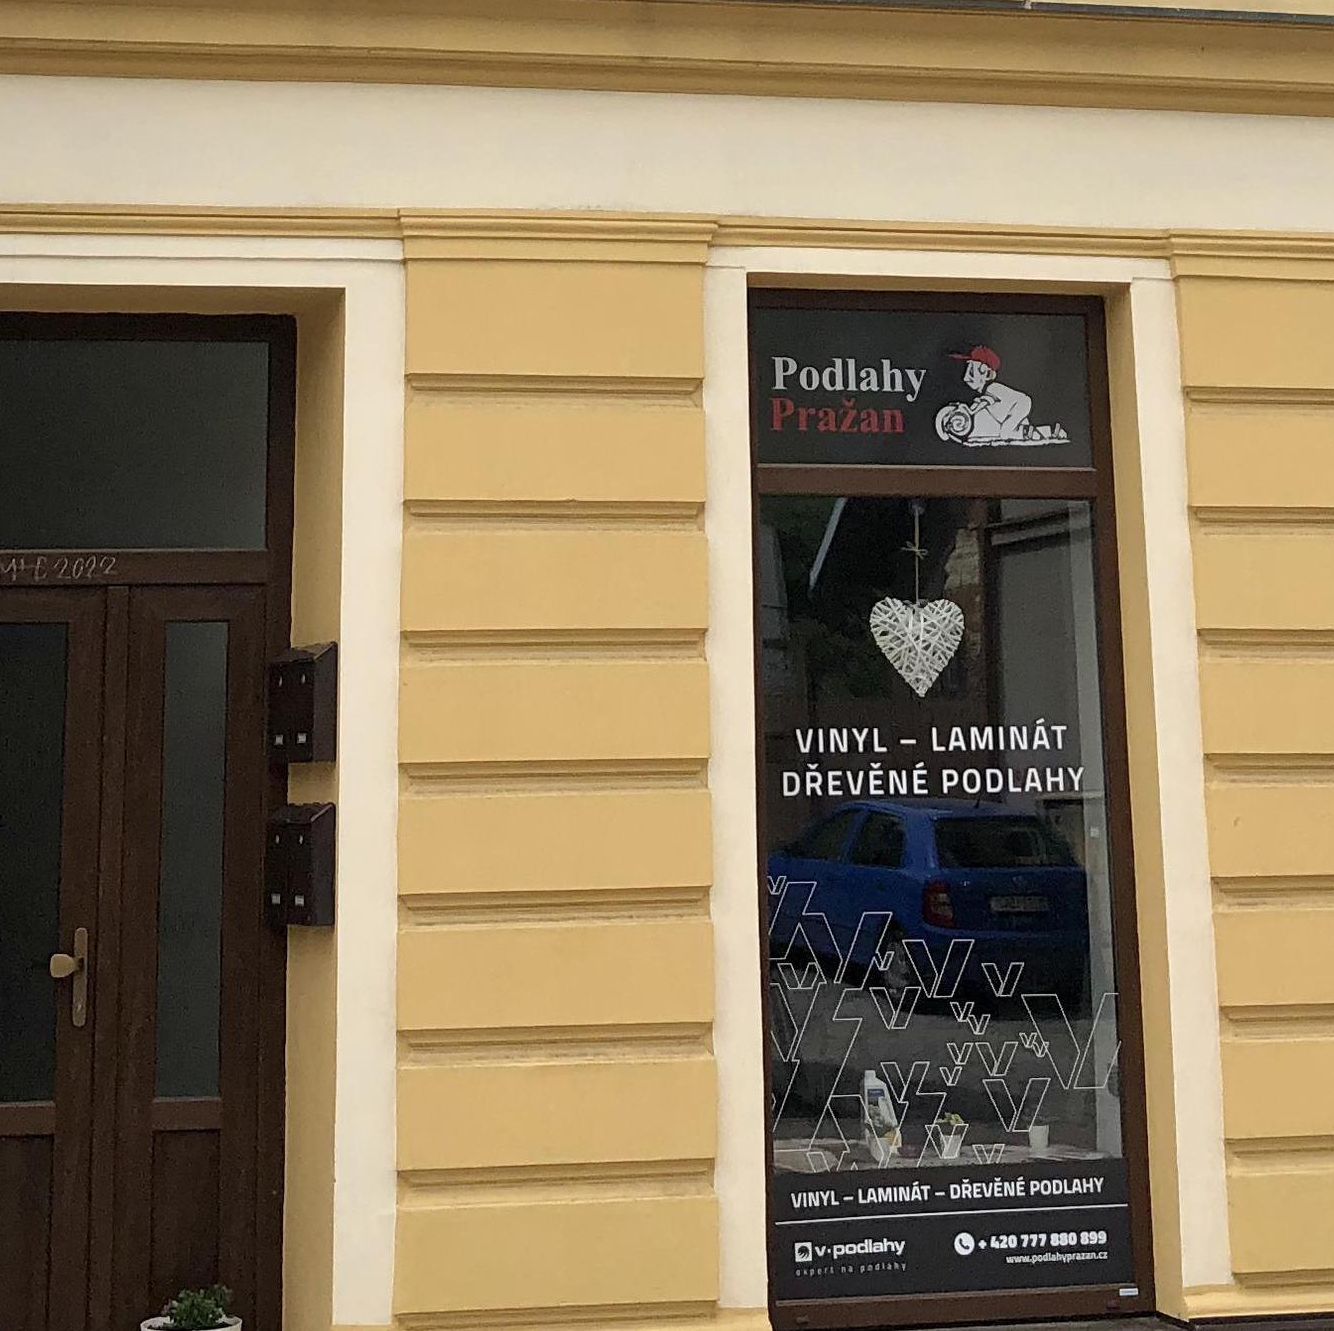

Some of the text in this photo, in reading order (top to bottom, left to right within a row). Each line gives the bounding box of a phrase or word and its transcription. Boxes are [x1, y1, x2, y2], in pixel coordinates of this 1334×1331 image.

[771, 356, 927, 402] Podlahy
[770, 397, 905, 433] Pražan
[53, 555, 116, 580] 2022
[795, 727, 887, 753] VINYL
[931, 718, 1067, 751] LAMINÁT
[783, 762, 1084, 796] DŘEVĚNÉ PODLAHY
[791, 1190, 839, 1208] VINYL
[858, 1182, 930, 1204] LAMINÁT
[950, 1177, 1025, 1200] DŘEVĚNÉ
[1029, 1177, 1104, 1196] PODLAHY
[990, 1235, 1017, 1249] 420
[1020, 1233, 1047, 1247] 777
[1006, 1251, 1108, 1265] www.podlahyprazan.cz
